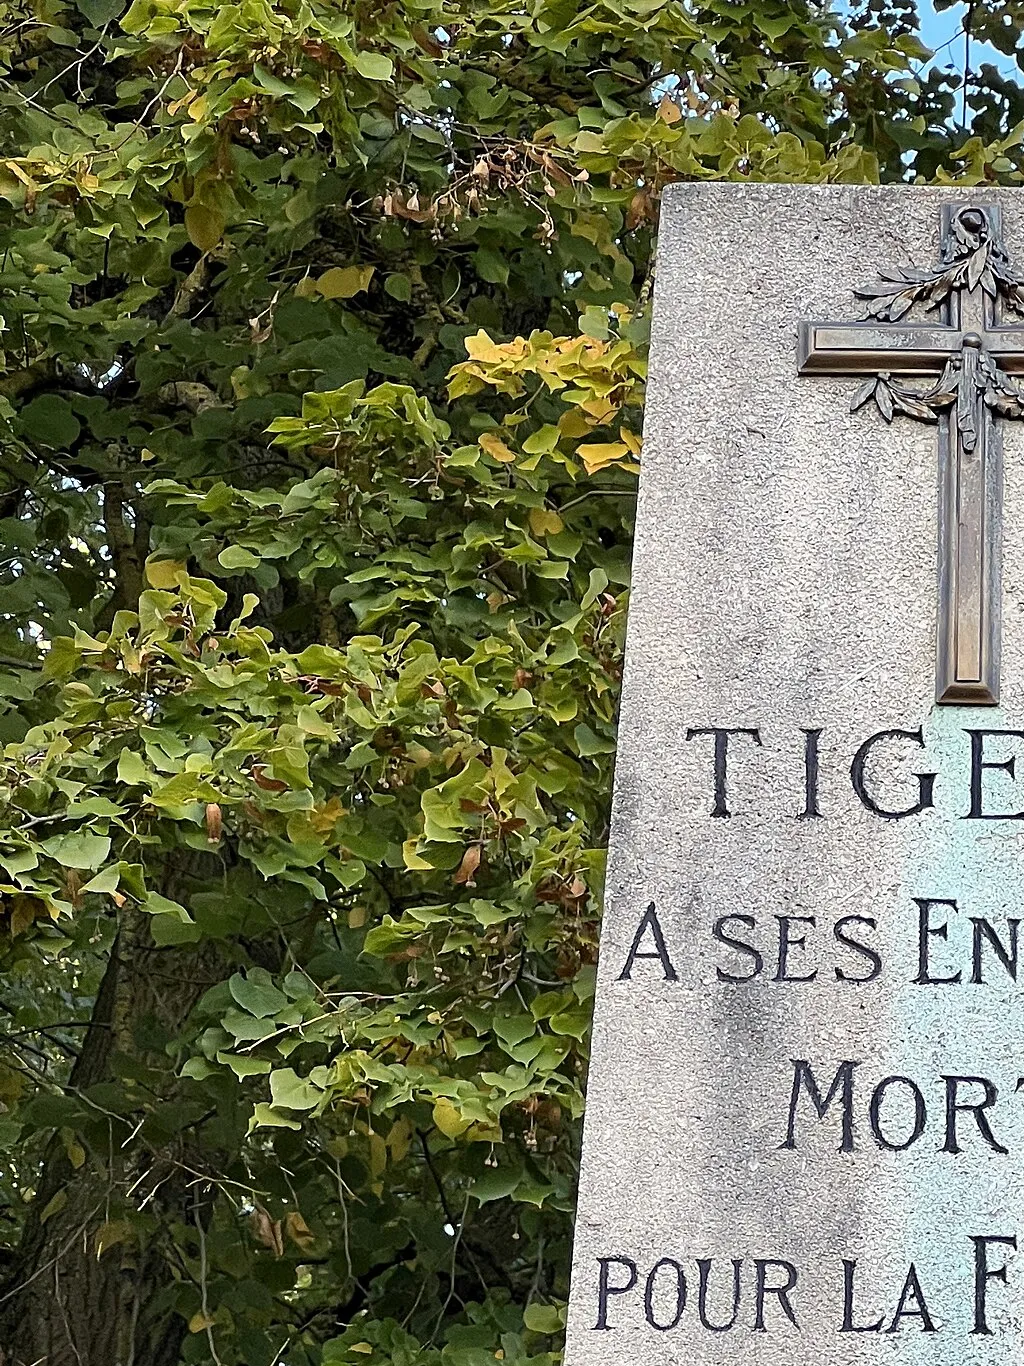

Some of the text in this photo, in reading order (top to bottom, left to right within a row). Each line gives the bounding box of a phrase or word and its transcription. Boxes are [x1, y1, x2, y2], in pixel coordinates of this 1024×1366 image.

[619, 901, 678, 982] A
[711, 914, 883, 985] SES
[591, 1256, 800, 1332] POUR
[837, 1258, 941, 1333] LA
